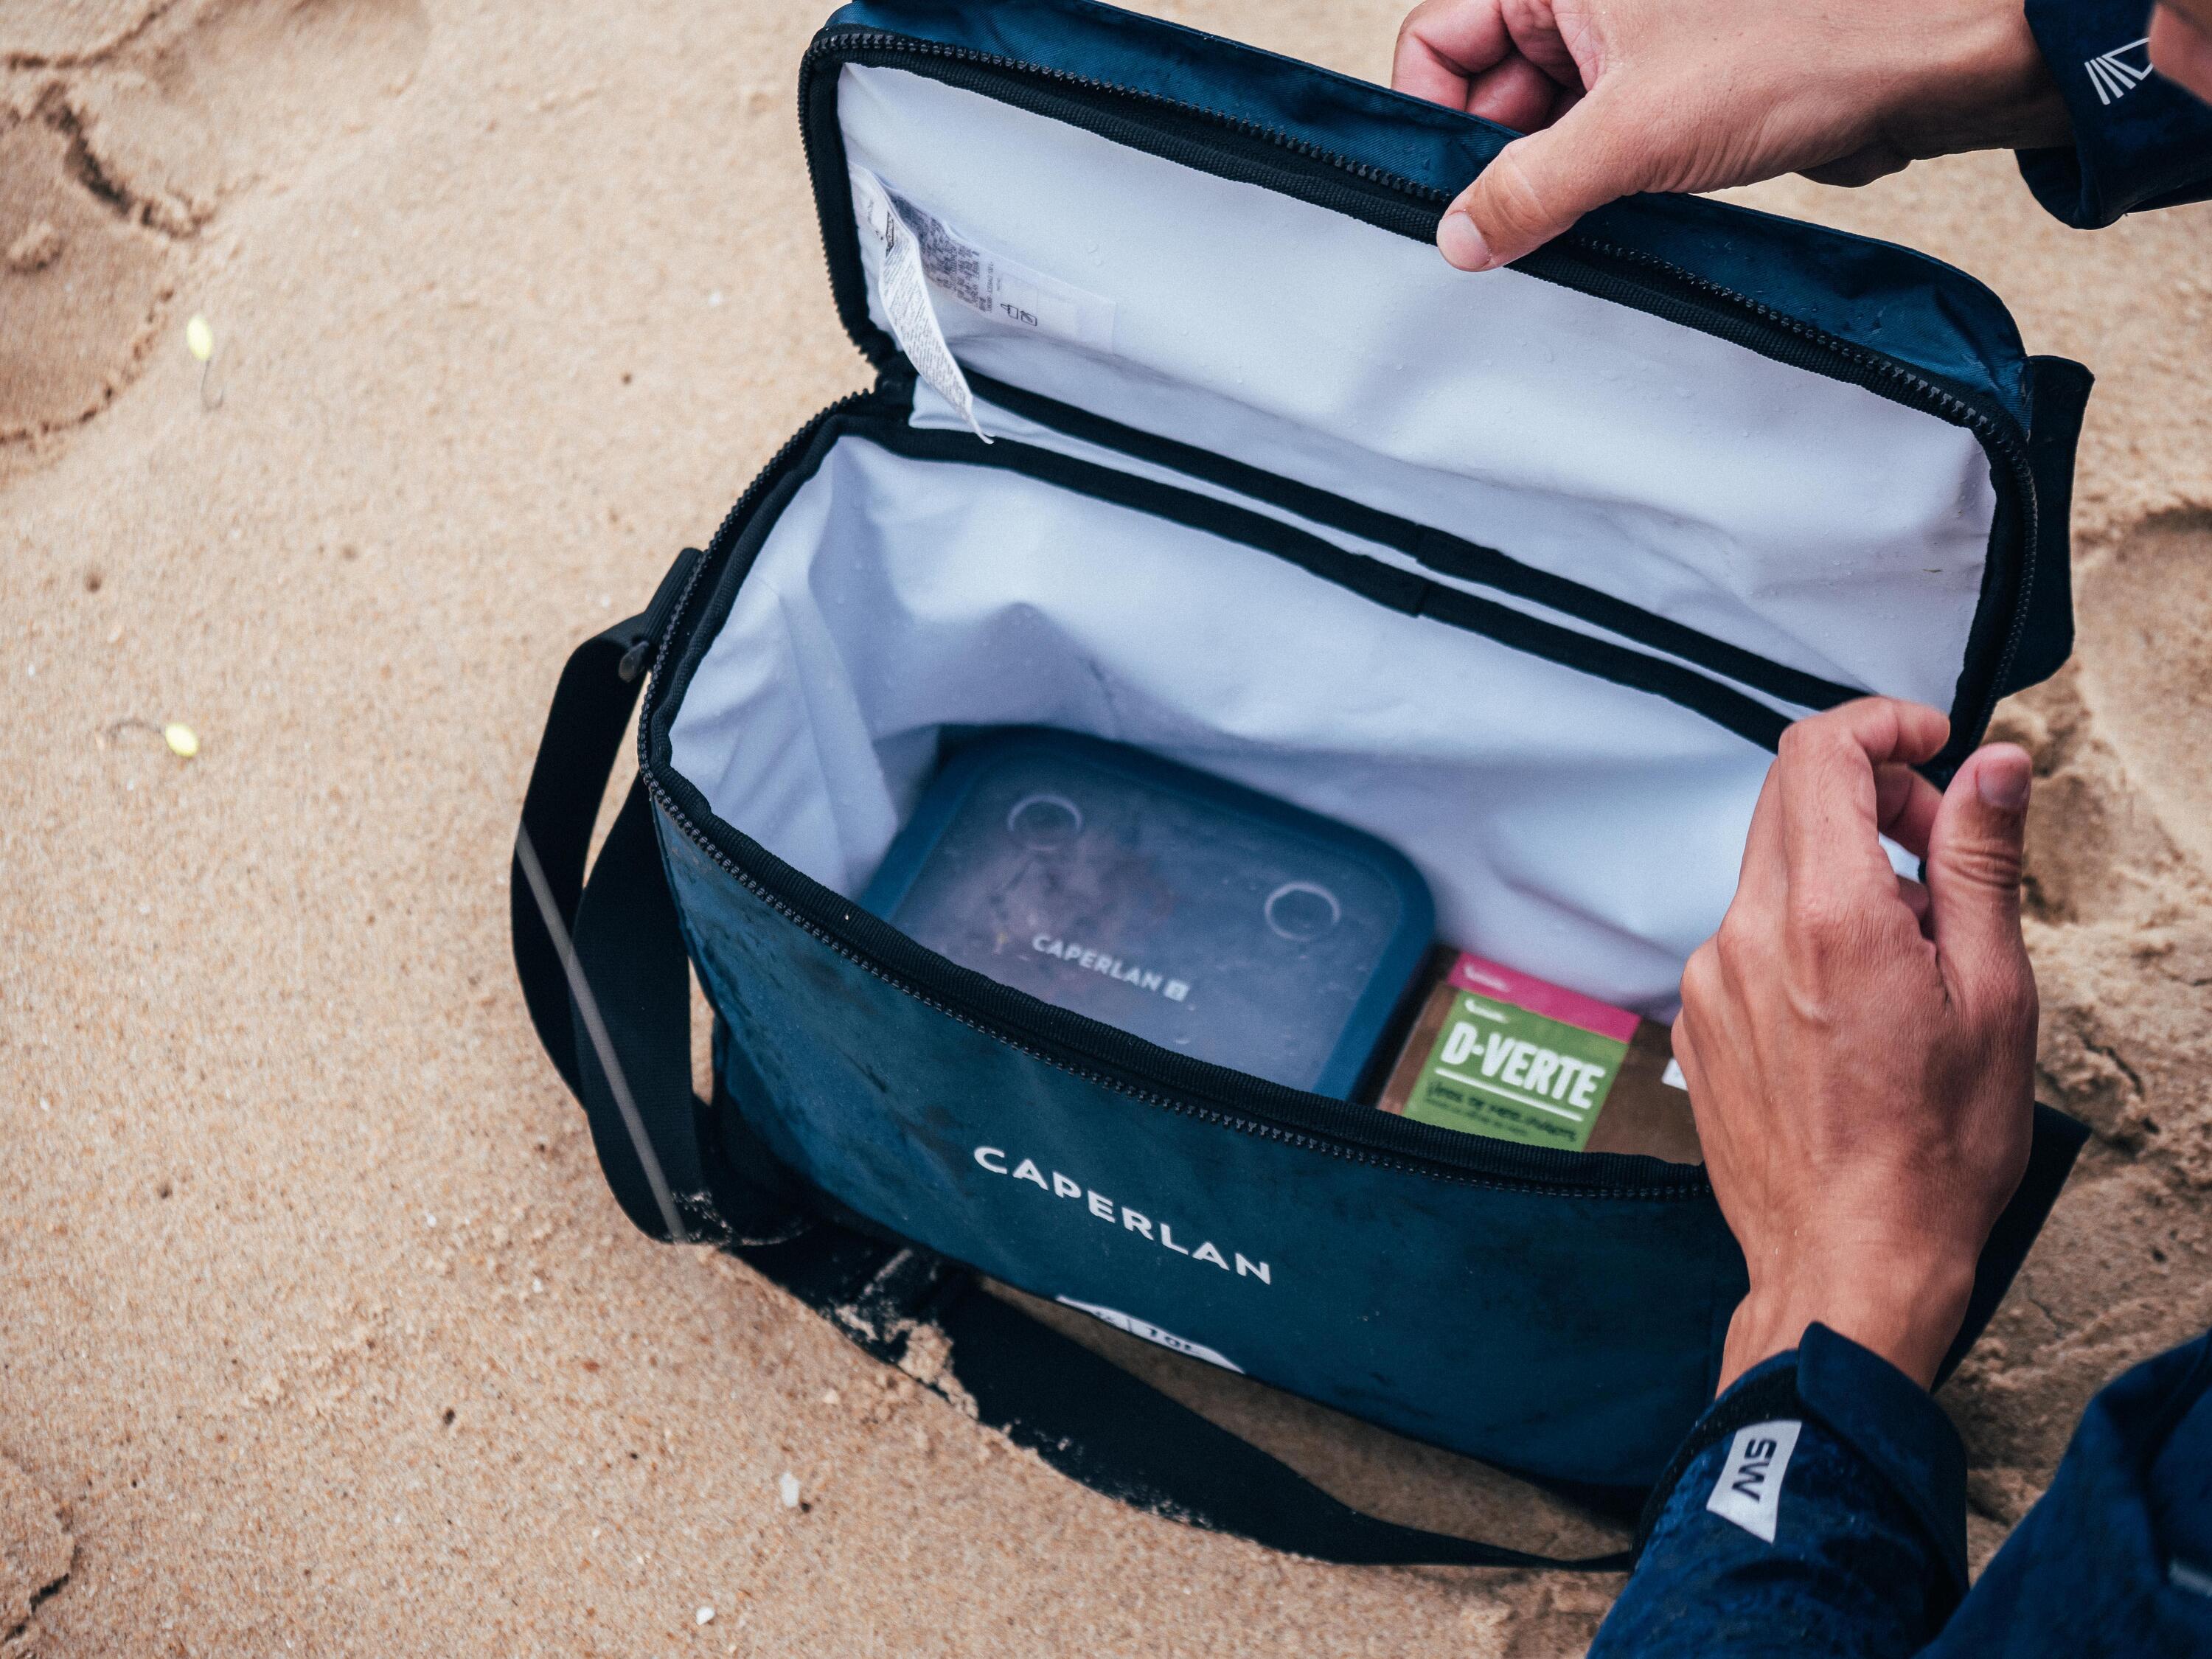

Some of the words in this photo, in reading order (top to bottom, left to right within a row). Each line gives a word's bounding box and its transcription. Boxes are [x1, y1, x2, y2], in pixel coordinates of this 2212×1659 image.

[1032, 933, 1162, 991] CAPERLAN
[1440, 1021, 1606, 1109] D-VERTE
[973, 1145, 1272, 1285] CAPERLAN
[1731, 1439, 1778, 1504] SW
